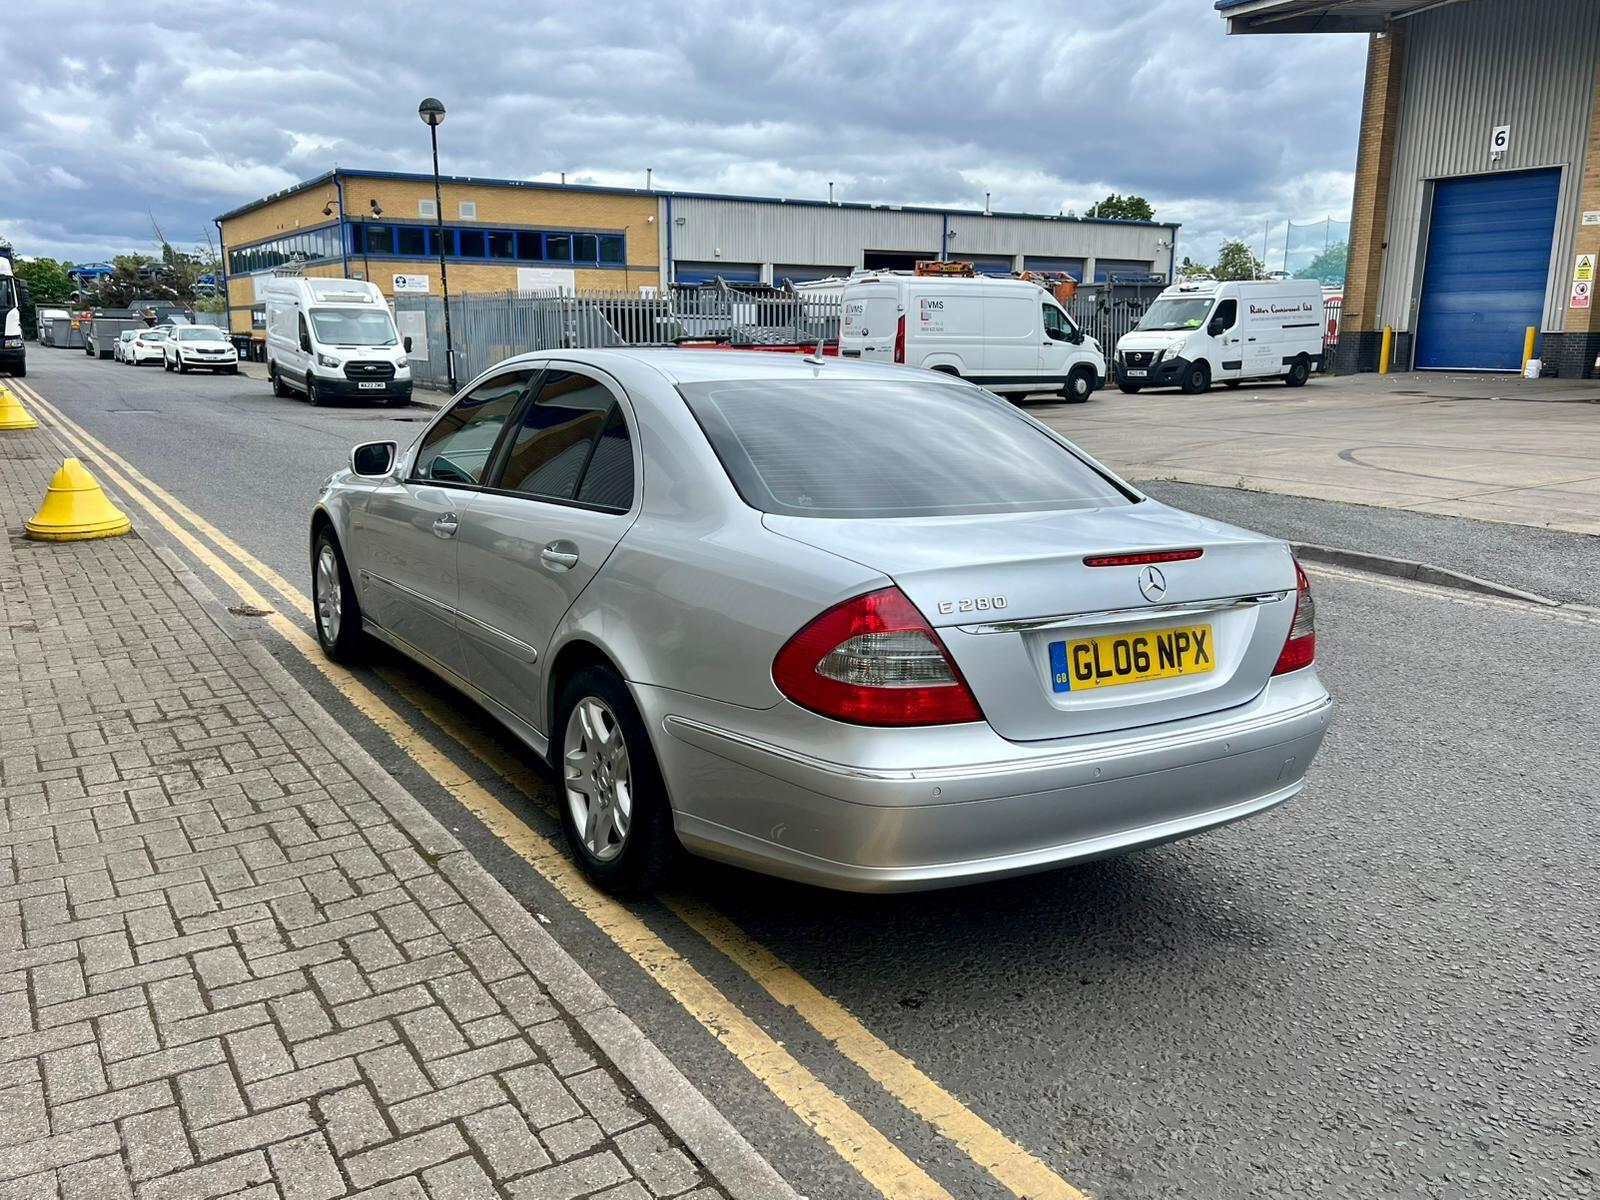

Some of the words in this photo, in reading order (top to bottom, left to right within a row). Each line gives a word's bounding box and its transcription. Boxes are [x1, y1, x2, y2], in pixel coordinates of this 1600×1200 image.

[1495, 130, 1506, 147] 6
[850, 304, 864, 313] VMS
[927, 300, 944, 310] VMS
[938, 600, 953, 614] E
[959, 595, 1007, 612] 280
[1073, 637, 1150, 681] GL06
[1157, 629, 1210, 671] NPX
[1056, 672, 1067, 684] GB
